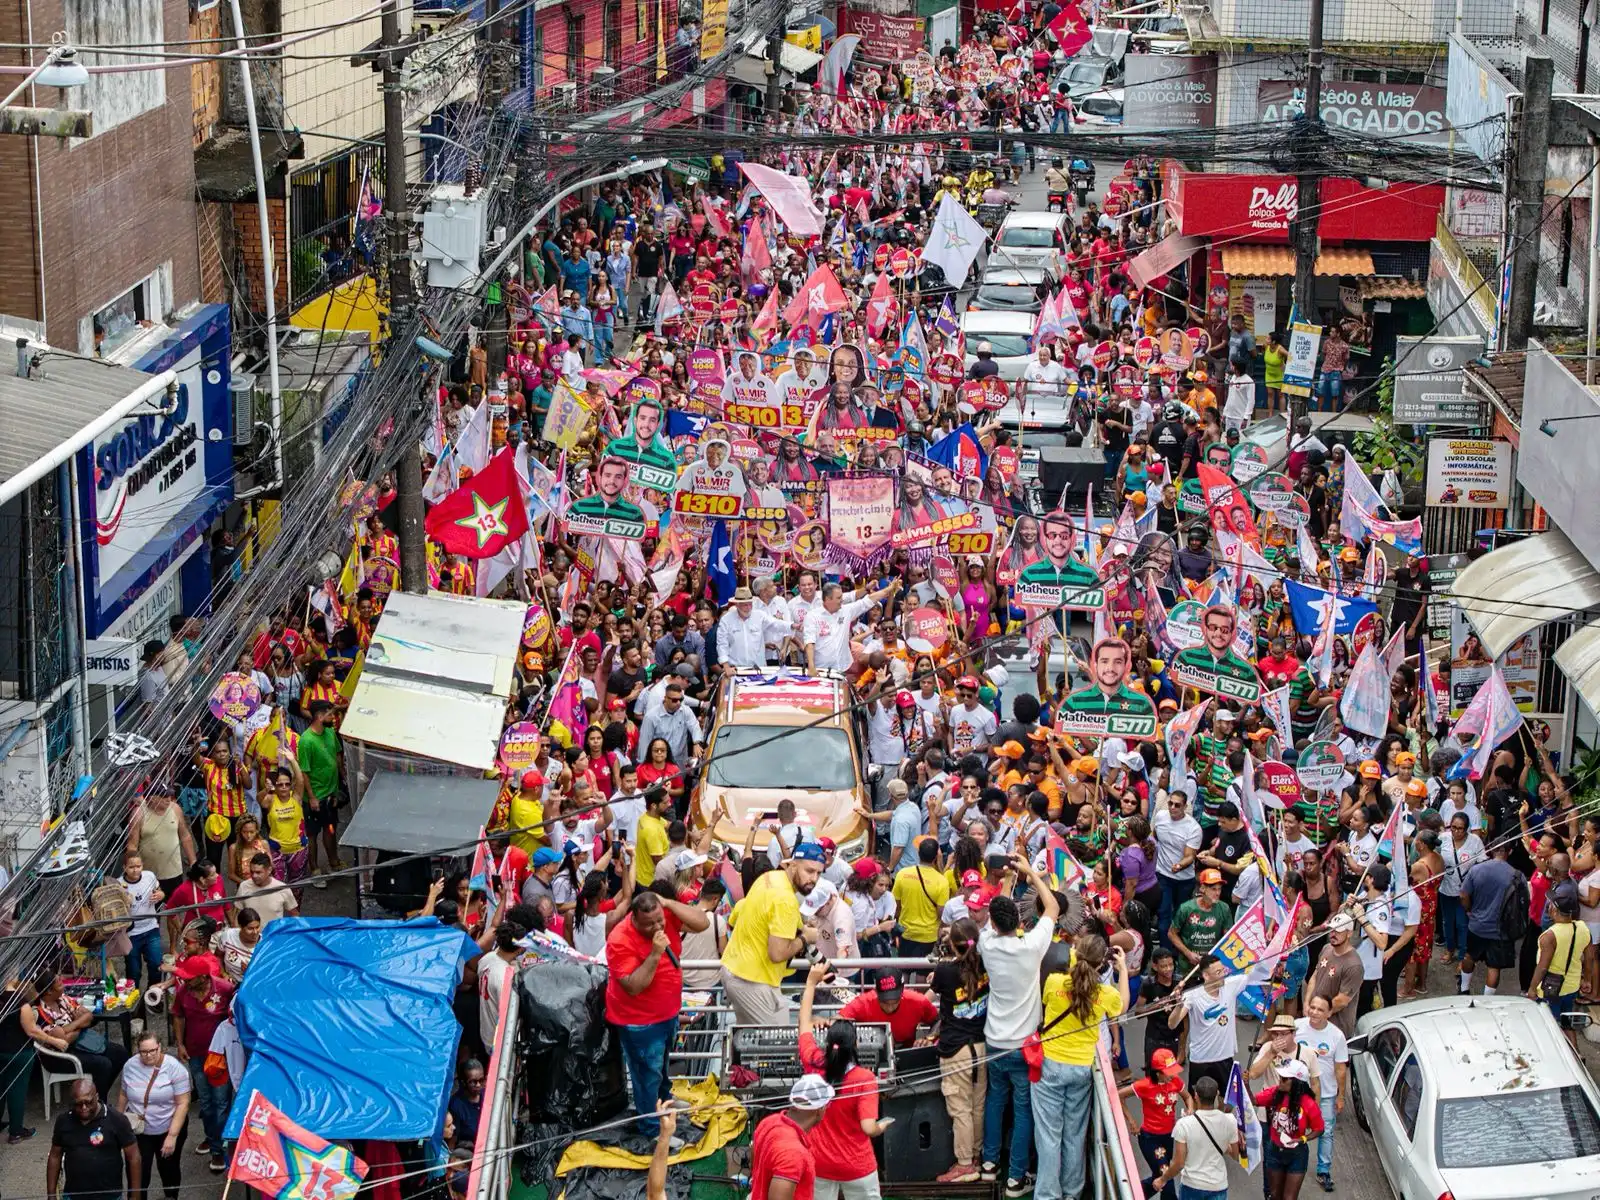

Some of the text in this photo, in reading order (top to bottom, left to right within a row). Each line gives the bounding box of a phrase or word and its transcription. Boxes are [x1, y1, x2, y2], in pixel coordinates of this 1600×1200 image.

[1129, 92, 1212, 104] ADVOGADOS
[1293, 88, 1414, 108] Mcêdo & Maia
[1263, 104, 1443, 135] ADOGADOS
[1249, 208, 1276, 218] polpas
[735, 387, 767, 398] VALMIR
[787, 387, 812, 398] VALM
[727, 405, 777, 426] 1310
[818, 427, 896, 439] OÍVIA 6550
[640, 467, 674, 487] 15777
[695, 477, 730, 487] VALMIR
[768, 481, 807, 490] OÍVIA
[1180, 491, 1206, 505] Mathe
[680, 496, 736, 515] 1310
[746, 508, 786, 519] 6550
[477, 513, 497, 532] 13
[565, 512, 643, 538] Matheus 15777
[932, 514, 976, 534] 6550
[856, 525, 872, 539] 13
[951, 534, 989, 552] 310
[1016, 583, 1060, 596] Matheus
[86, 656, 130, 671] ENTISTAS
[1173, 662, 1258, 698] Matheus 15777
[1057, 711, 1154, 733] Matheus 15777
[504, 742, 537, 753] 4040
